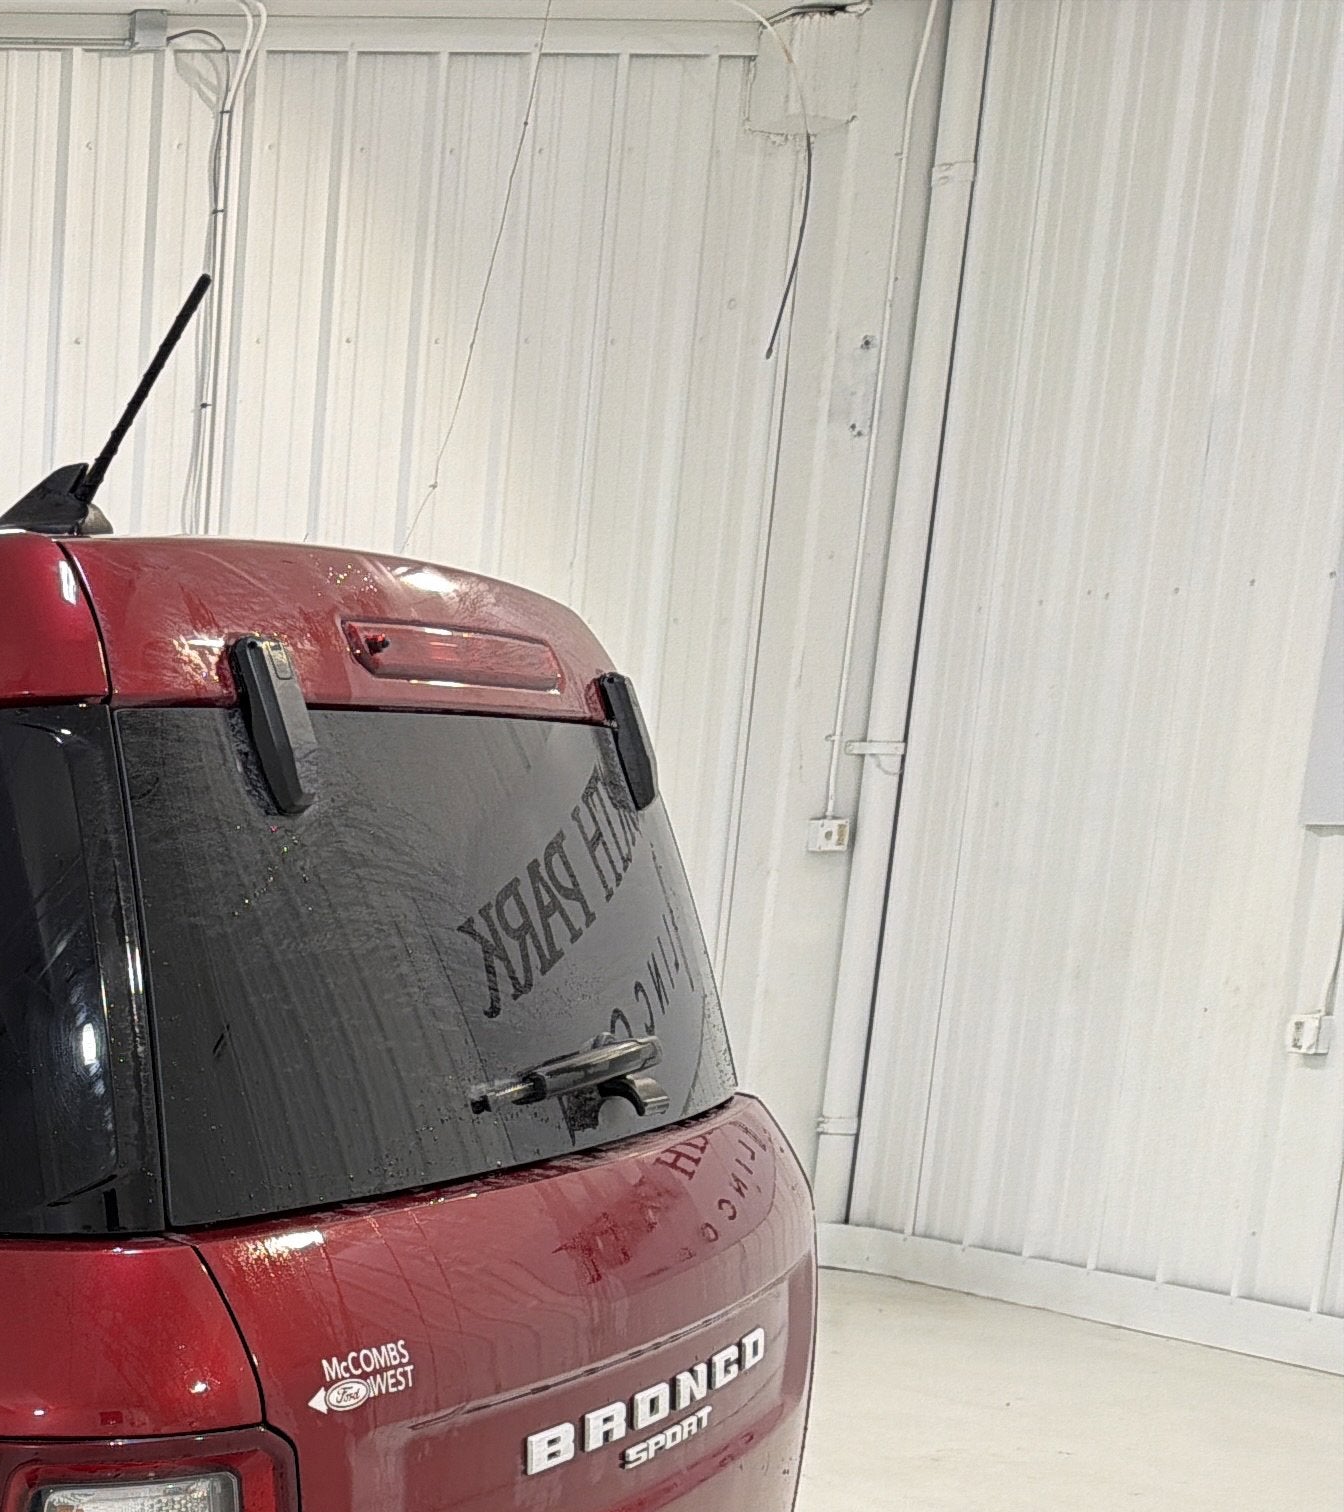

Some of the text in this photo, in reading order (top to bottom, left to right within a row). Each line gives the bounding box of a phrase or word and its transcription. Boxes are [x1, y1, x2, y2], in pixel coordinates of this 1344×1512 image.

[321, 1339, 410, 1382] McCOMBS
[370, 1364, 414, 1398] WEST
[526, 1327, 765, 1476] BRONCO
[624, 1405, 713, 1470] SPORT
